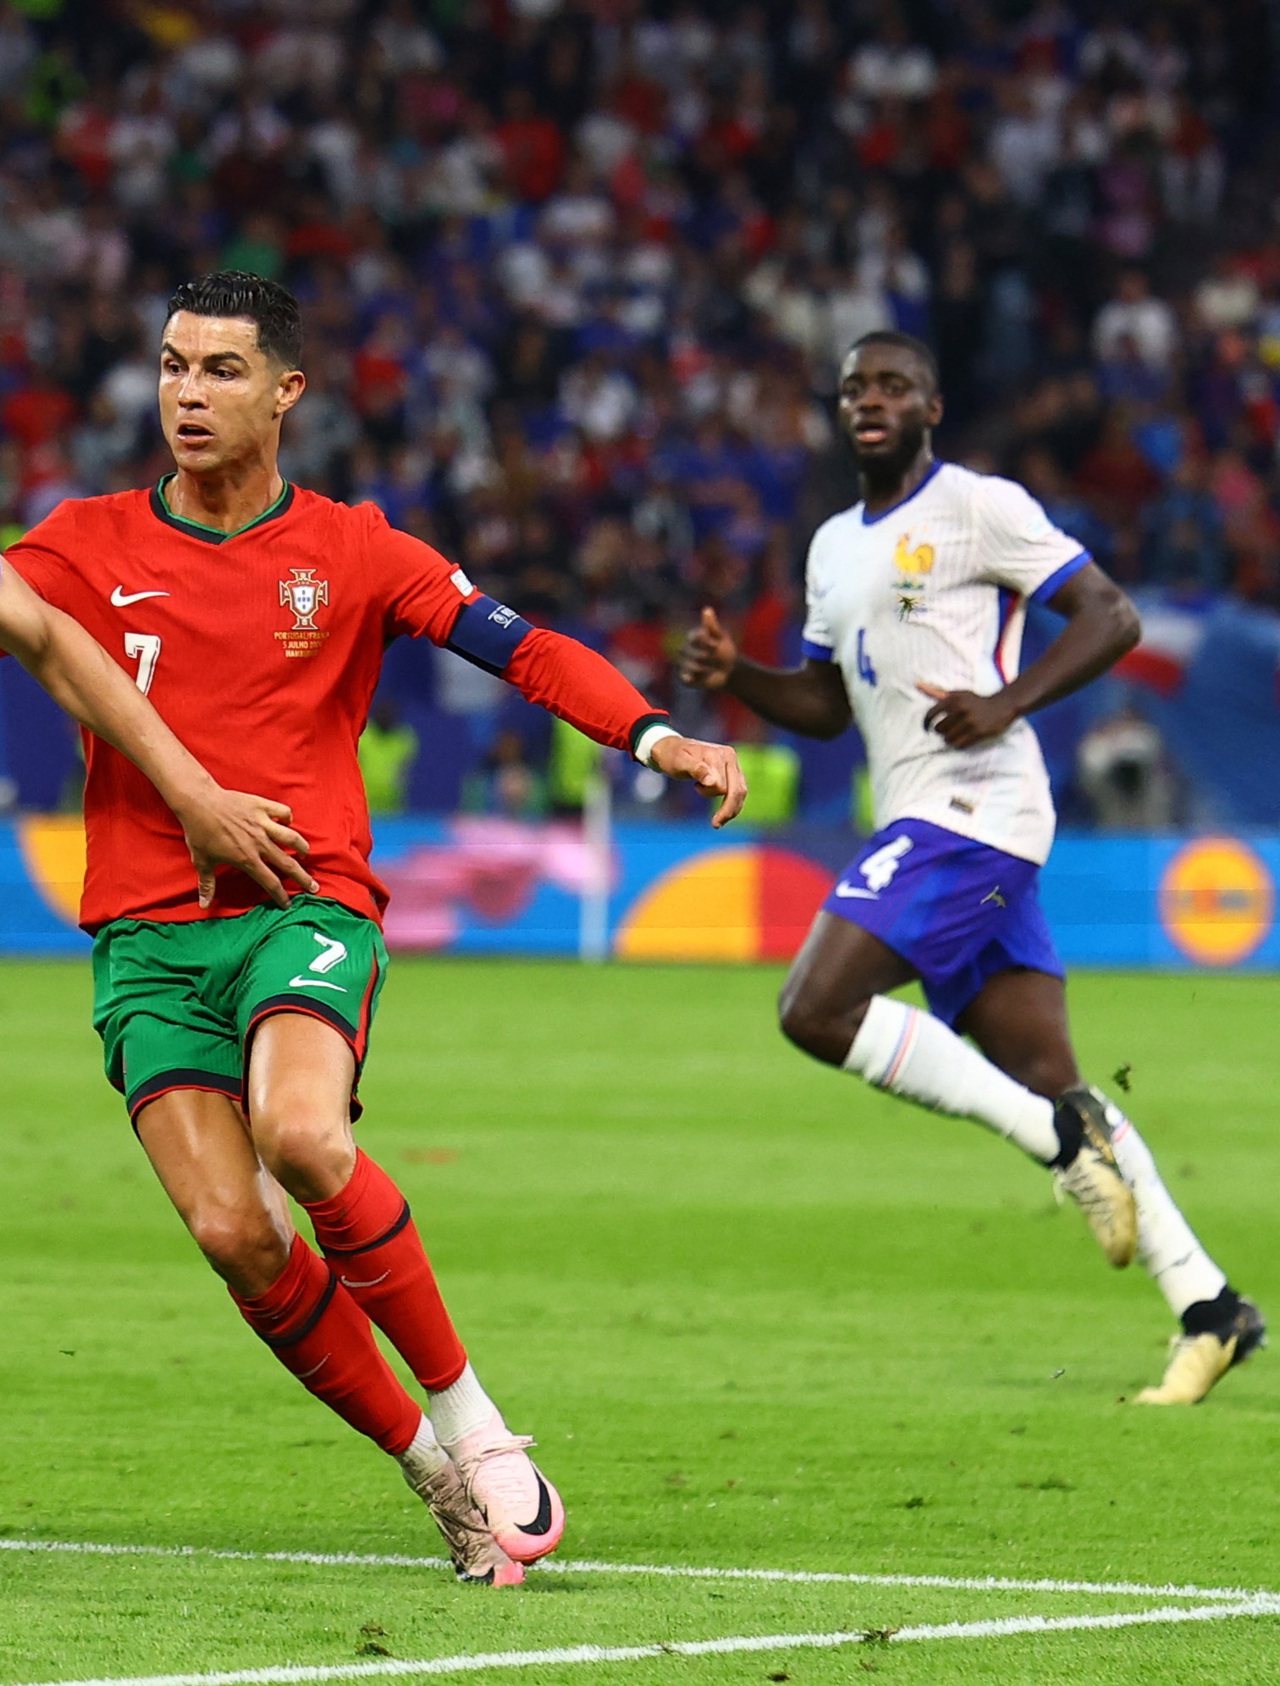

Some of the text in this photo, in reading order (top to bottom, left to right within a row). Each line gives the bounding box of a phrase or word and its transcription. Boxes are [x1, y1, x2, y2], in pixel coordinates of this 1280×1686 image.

[124, 632, 161, 696] 7
[288, 640, 309, 649] JULHO
[859, 834, 914, 893] 4
[308, 931, 348, 974] 7
